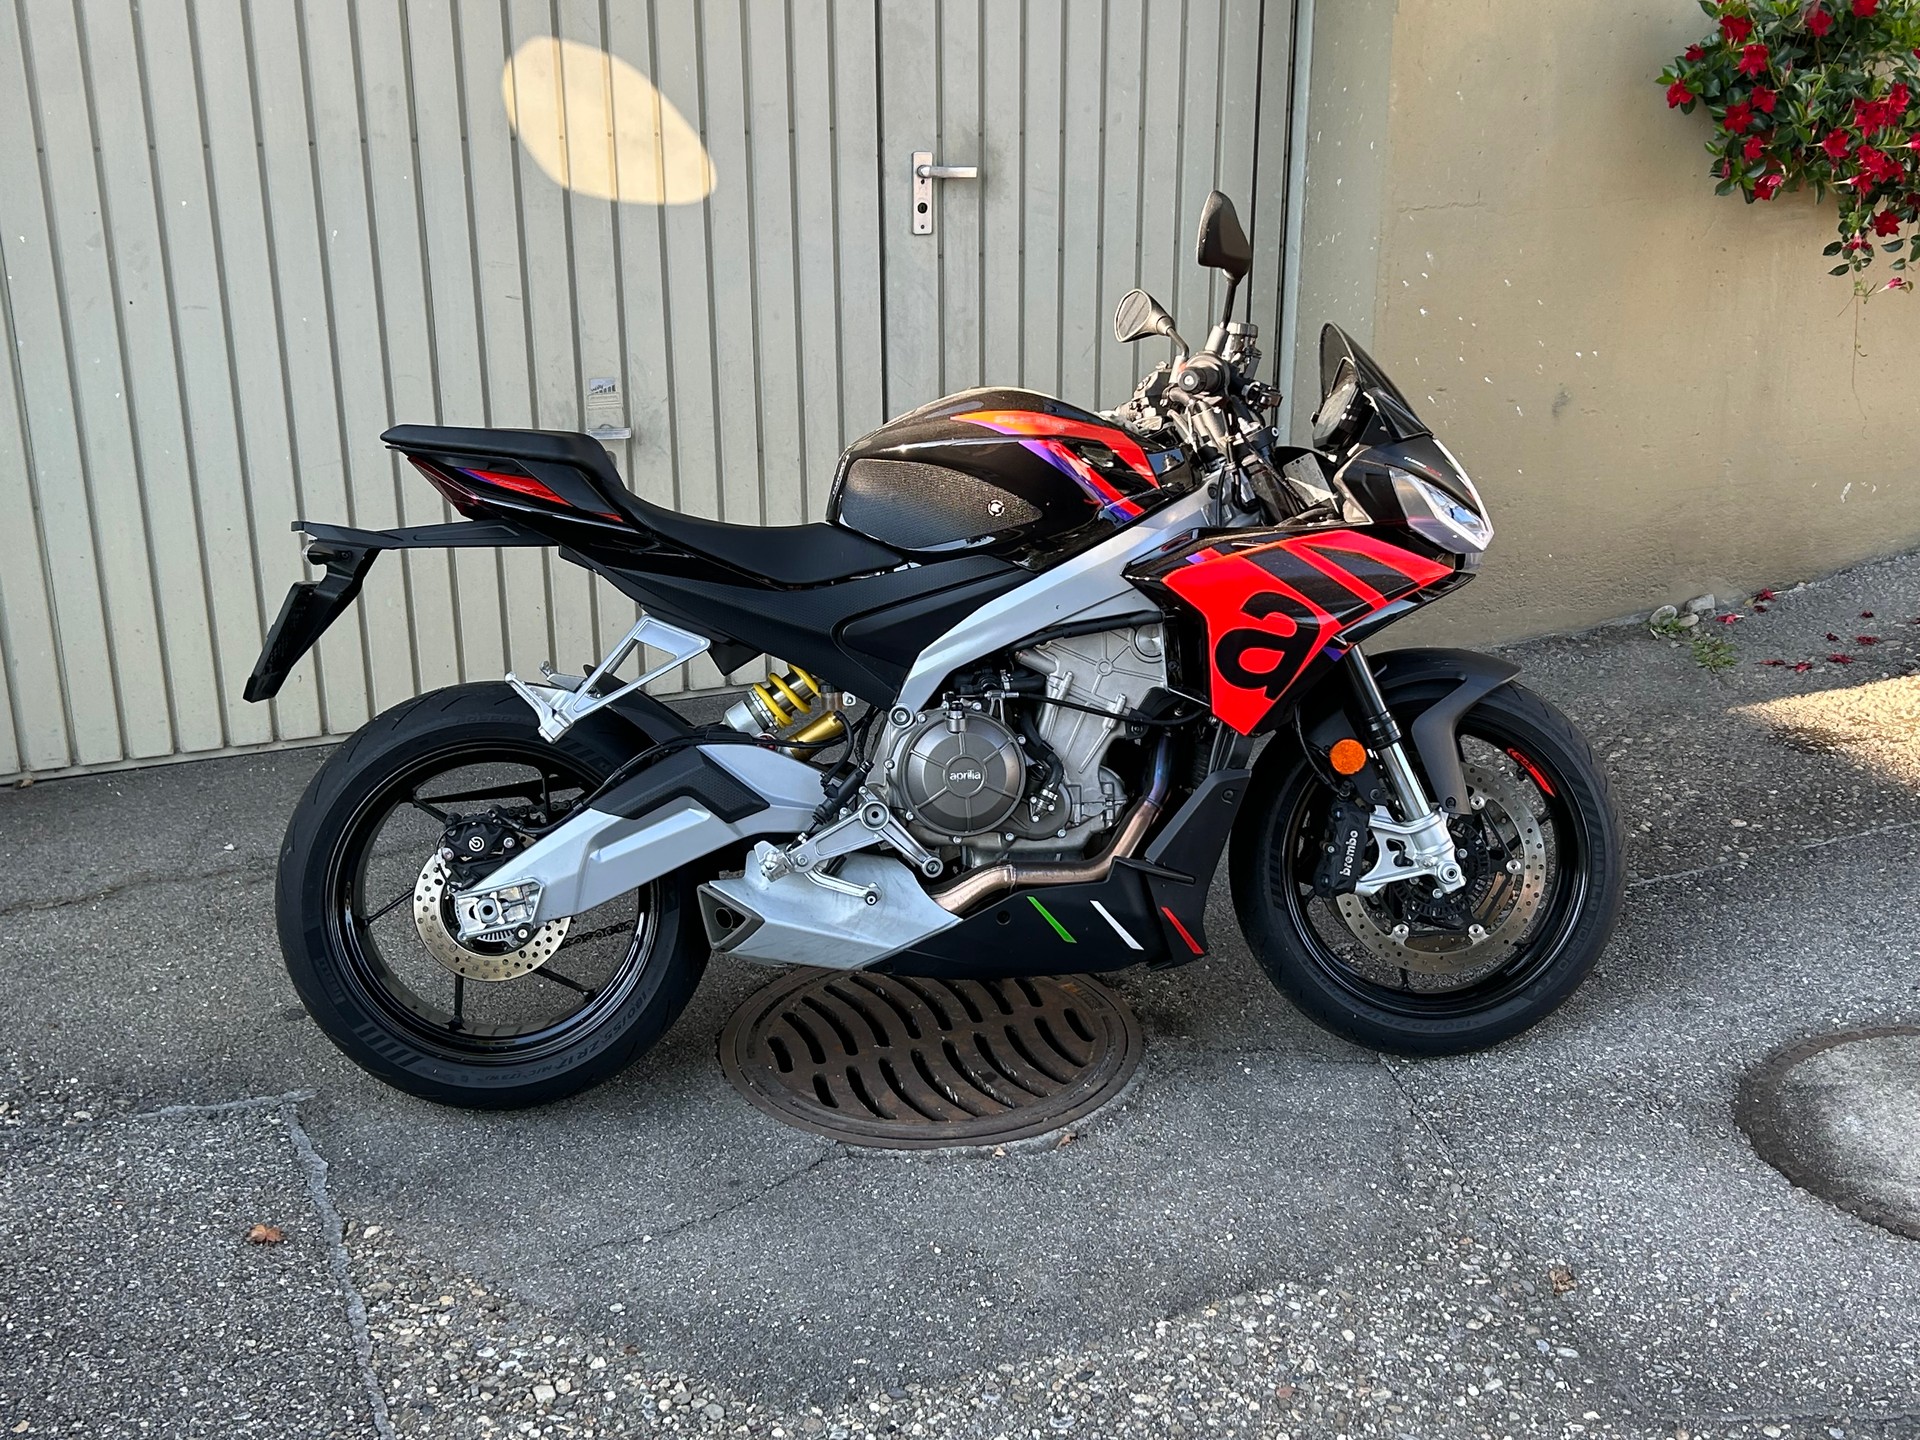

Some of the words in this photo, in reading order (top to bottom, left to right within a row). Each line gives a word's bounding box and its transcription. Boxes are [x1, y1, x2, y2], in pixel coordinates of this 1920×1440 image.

[949, 769, 981, 782] aprilia
[1340, 830, 1358, 876] brembo
[1556, 916, 1594, 971] ROSSO
[601, 990, 649, 1041] 180/55
[554, 1039, 603, 1069] ZR17
